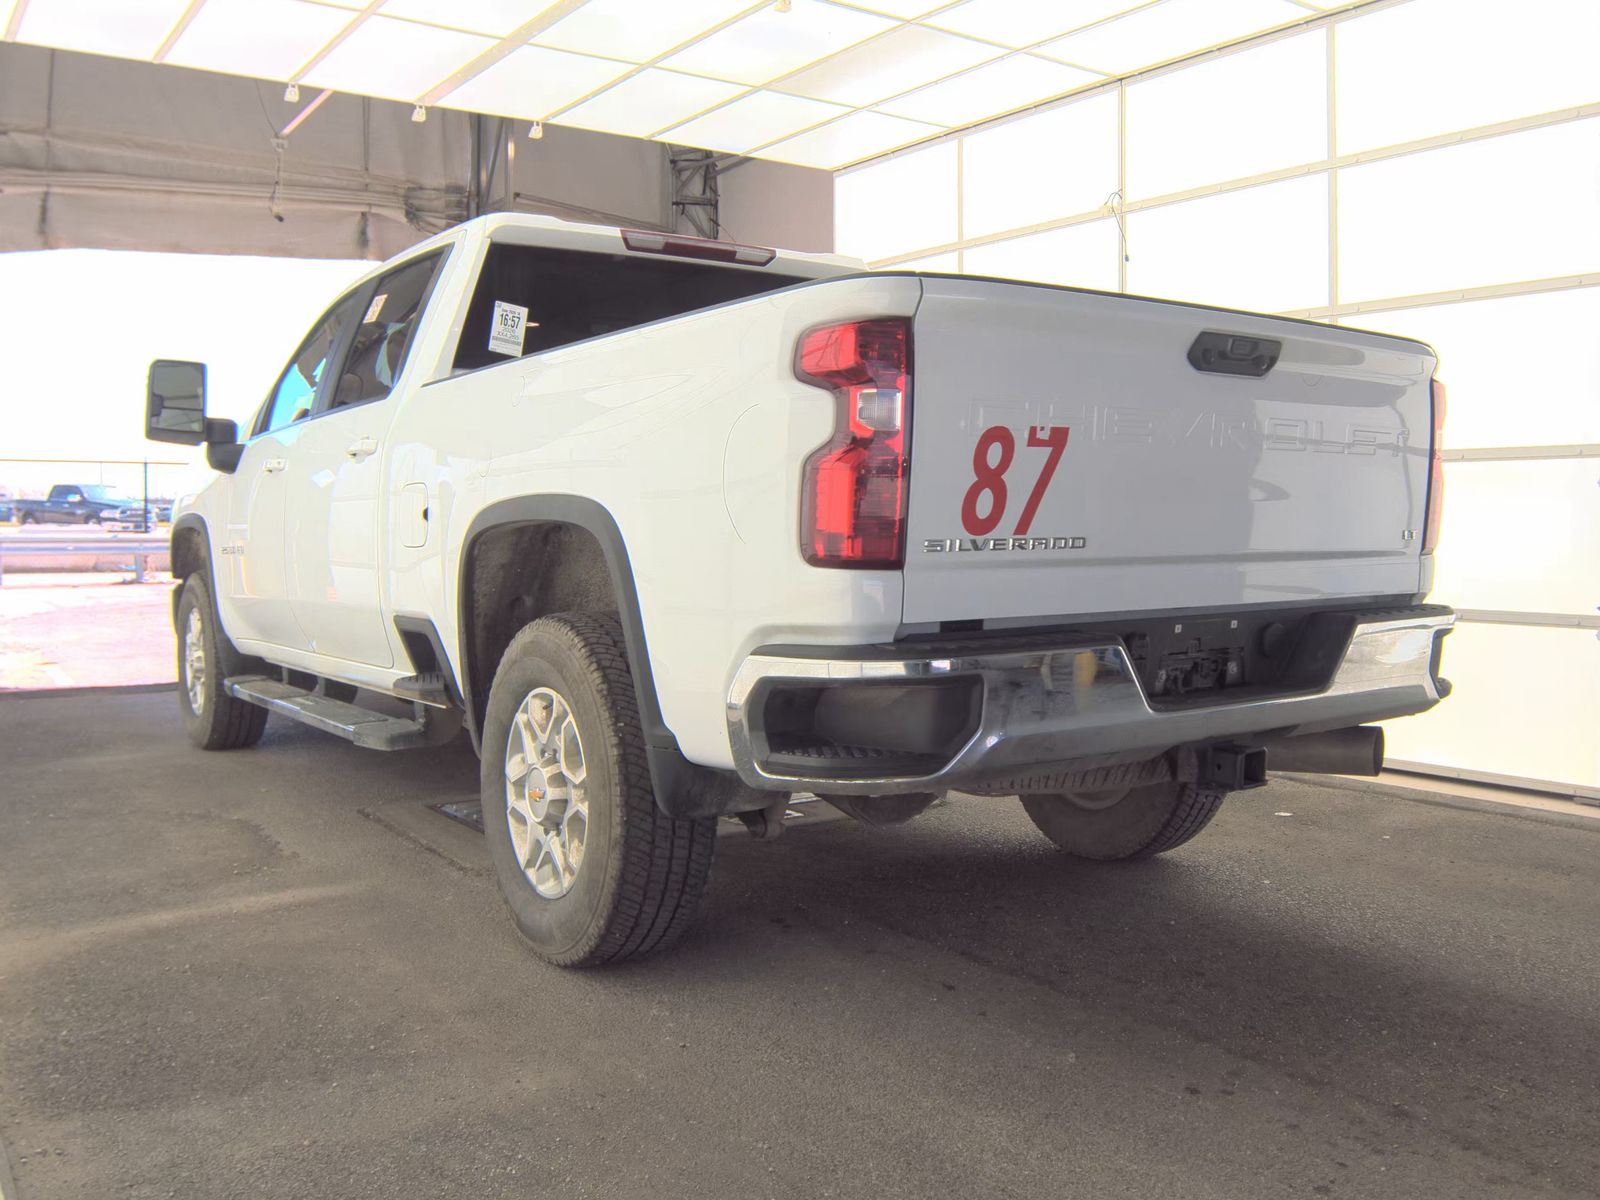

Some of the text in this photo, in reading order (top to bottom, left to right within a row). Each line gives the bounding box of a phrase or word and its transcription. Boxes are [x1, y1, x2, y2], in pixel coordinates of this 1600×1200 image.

[500, 313, 521, 329] 16:57
[961, 425, 1070, 536] 87
[923, 536, 1087, 553] SILVERADO
